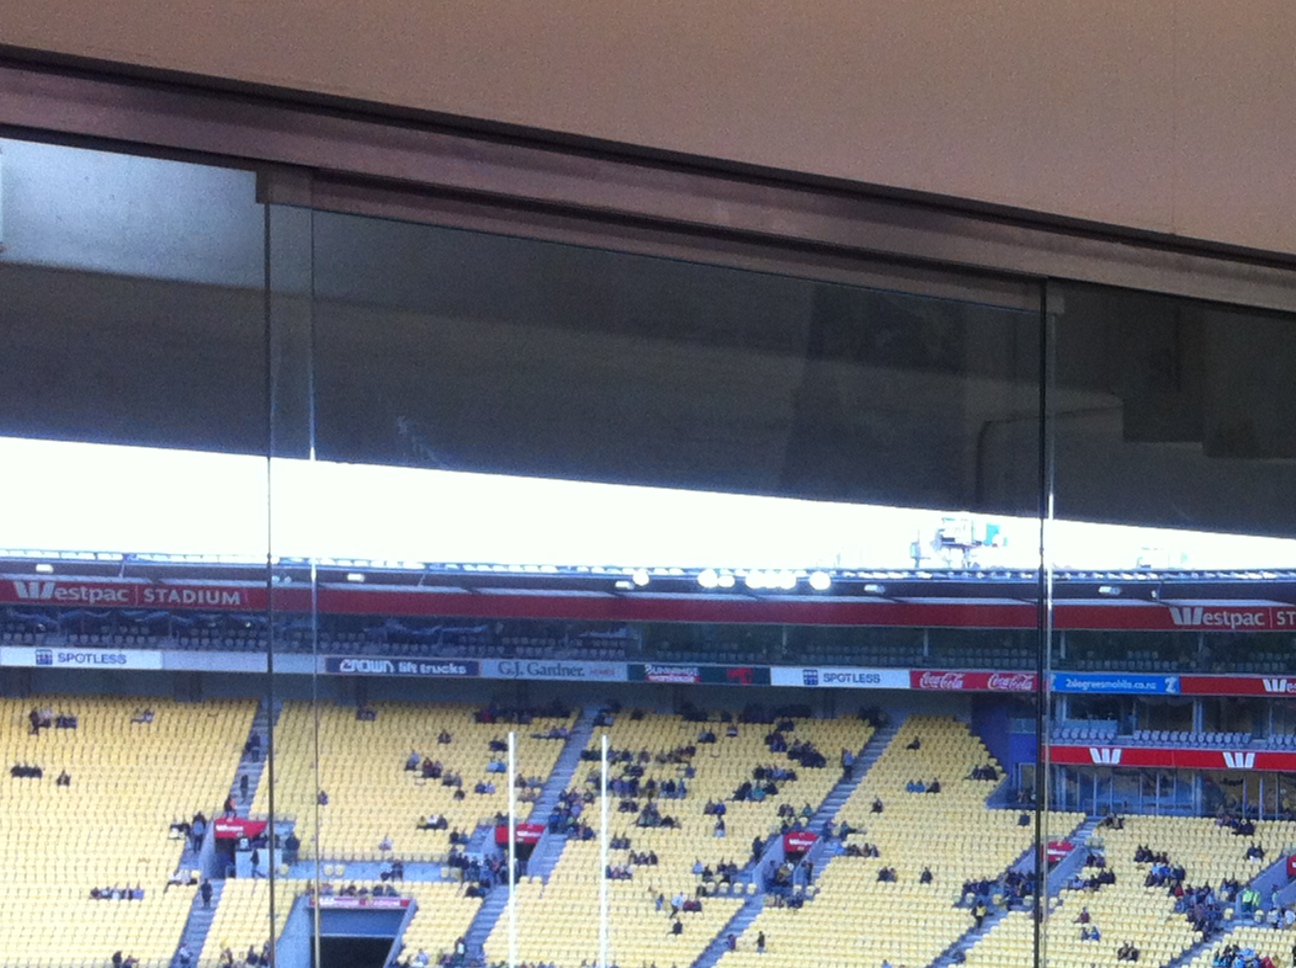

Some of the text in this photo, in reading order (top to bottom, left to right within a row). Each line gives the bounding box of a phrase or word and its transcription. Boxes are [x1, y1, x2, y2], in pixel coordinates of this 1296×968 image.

[13, 581, 242, 605] Westpac STADIUM
[1169, 607, 1265, 628] Westpac
[57, 653, 127, 665] SPOTLESS
[420, 662, 467, 675] trucks
[823, 673, 881, 684] SPOTLESS
